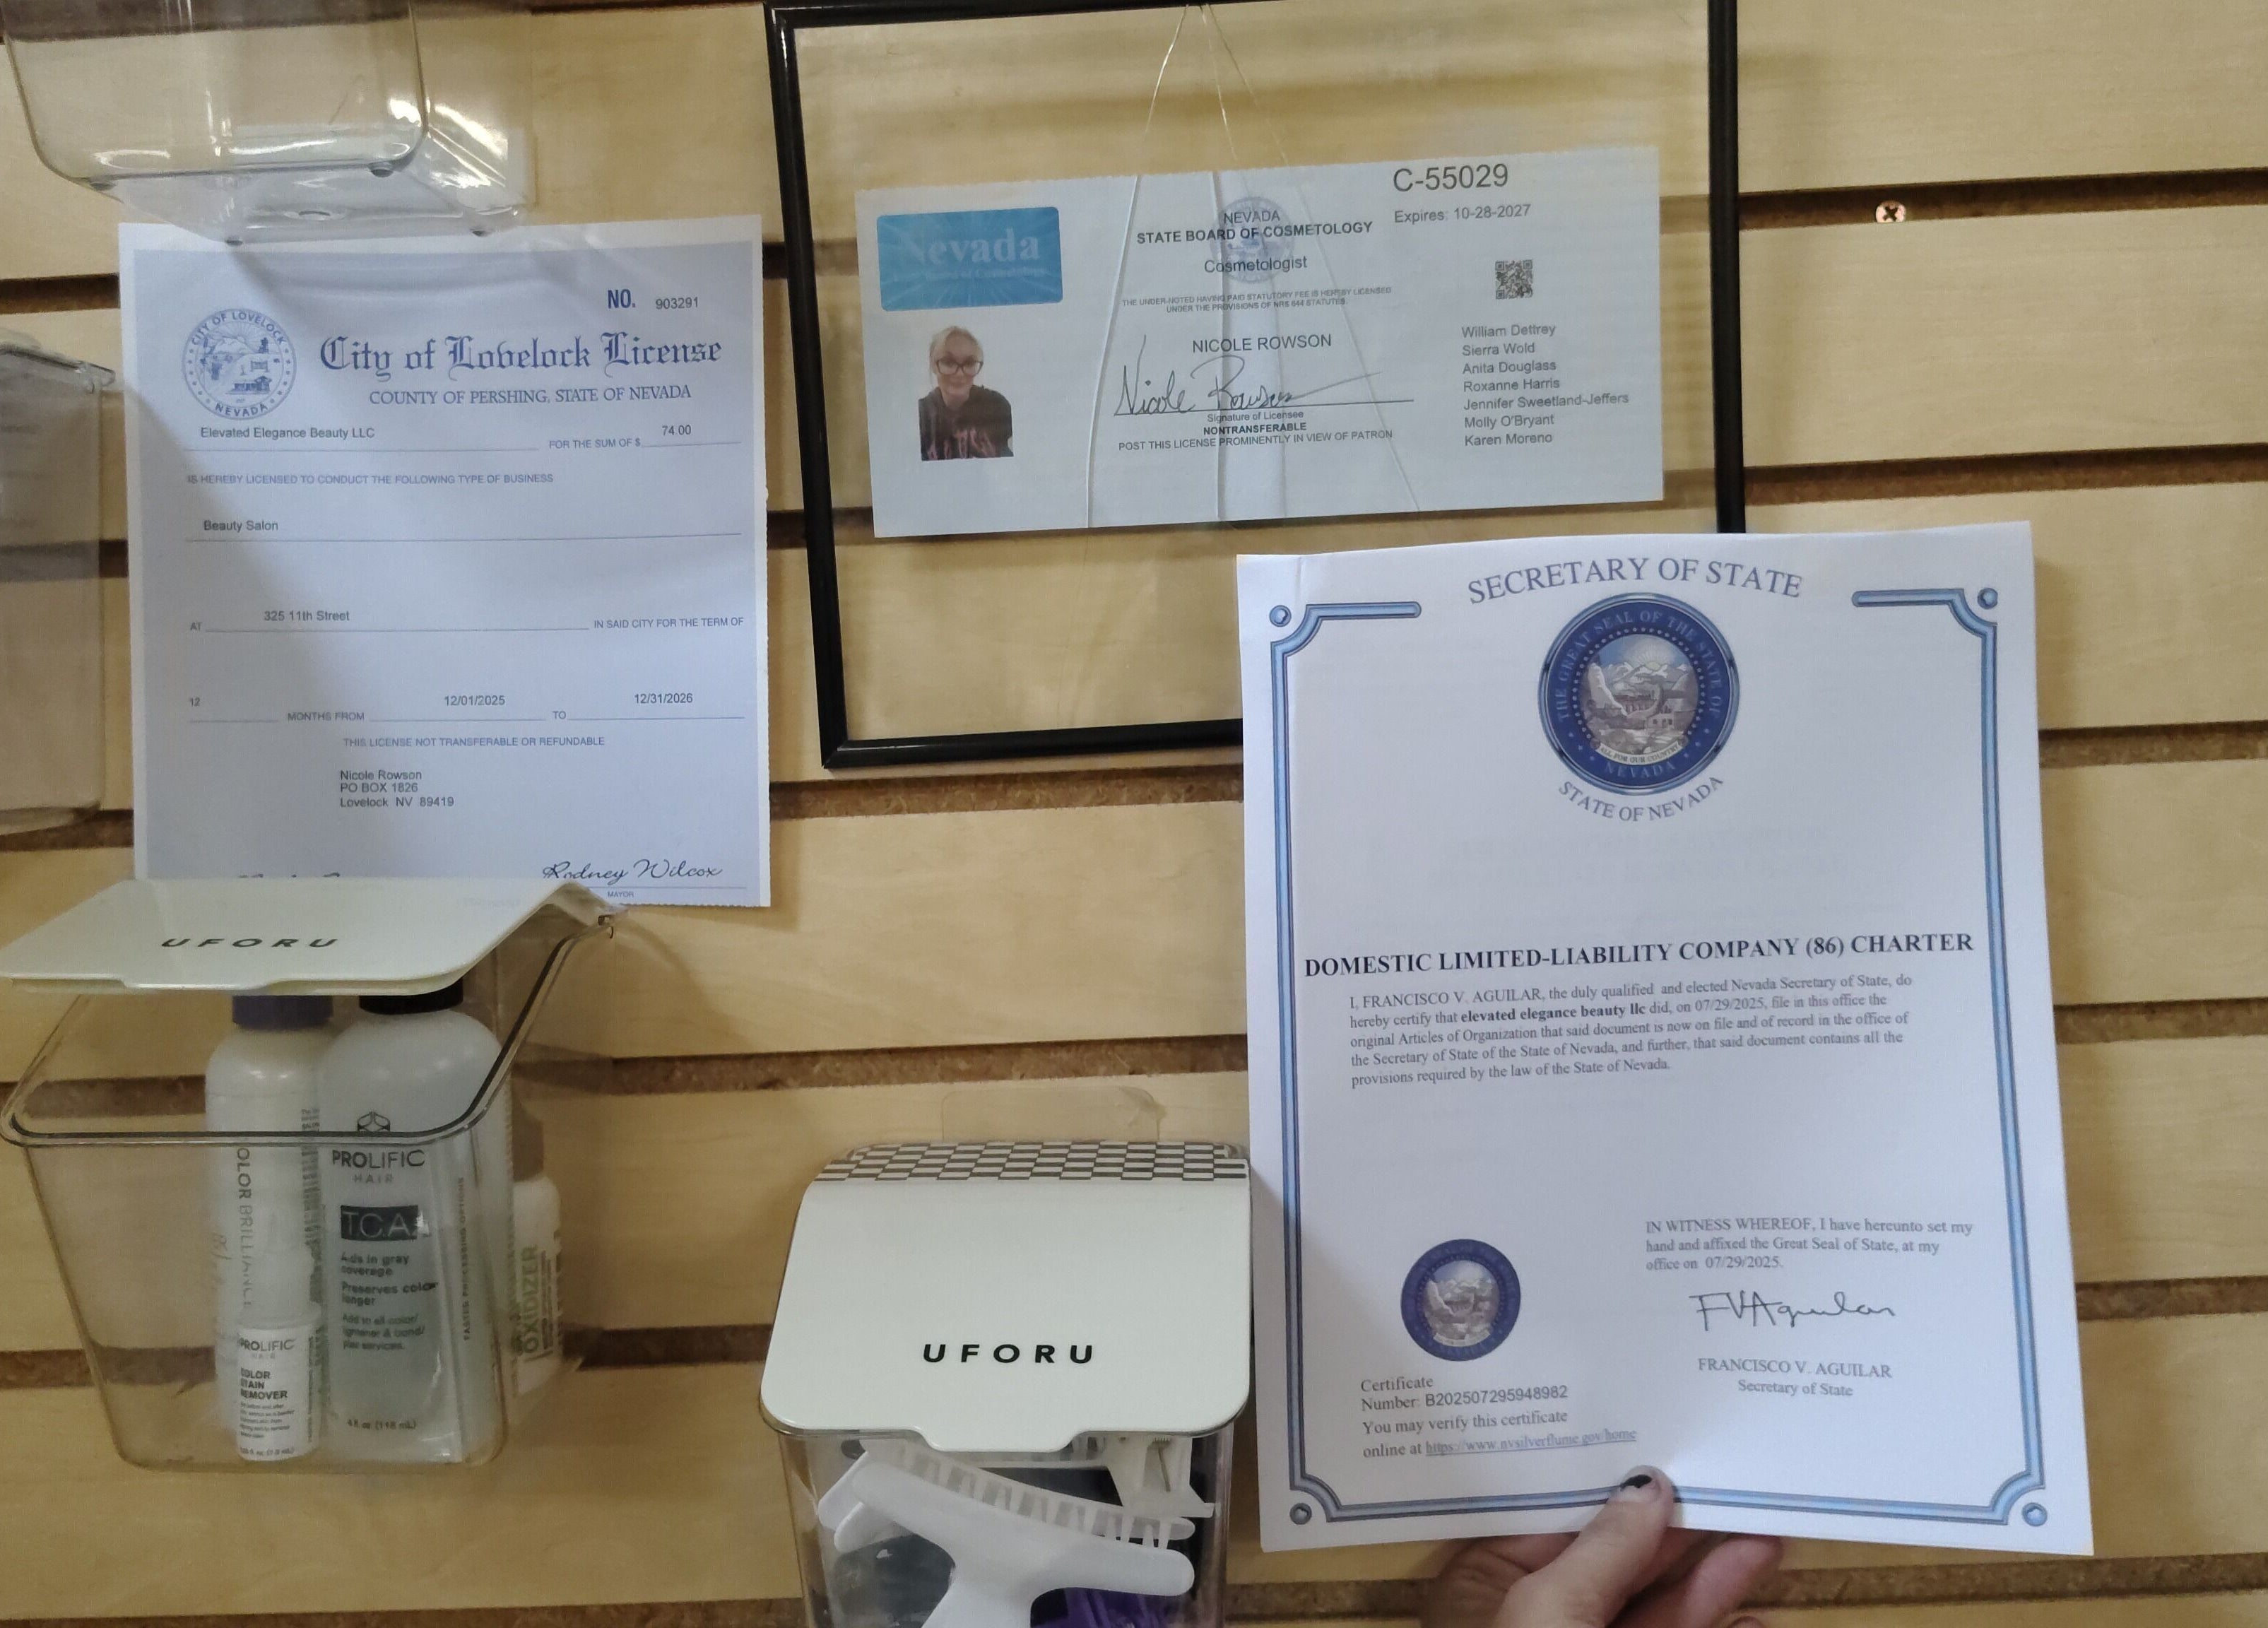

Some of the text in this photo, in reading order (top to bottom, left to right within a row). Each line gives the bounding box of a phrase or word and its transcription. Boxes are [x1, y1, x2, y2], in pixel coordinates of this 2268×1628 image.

[1393, 163, 1508, 191] C-55029
[1223, 210, 1280, 224] NEVADA
[1454, 204, 1530, 219] 10-28-2027
[1137, 222, 1372, 244] STATE BOARD OF COSMETOLOGY
[1204, 256, 1306, 276] Cosmetologist
[608, 288, 697, 309] NO. 903291
[191, 311, 286, 346] CITY OF LOVELOCK
[1461, 326, 1506, 338] William
[1193, 334, 1330, 353] NICOLE ROWSON
[1462, 342, 1535, 356] Sierra Wold
[320, 331, 721, 382] City of Lovelock License
[1463, 360, 1556, 374] Anita Douglass
[1463, 377, 1559, 391] Roxanne Harris
[369, 391, 437, 404] COUNTY
[443, 391, 465, 403] OF
[555, 388, 598, 402] STATE
[603, 387, 625, 401] OF
[629, 384, 691, 400] NEVADA
[1463, 392, 1629, 410] Jennifer Sweetland-Jeffers
[214, 403, 268, 418] NEVADA
[1207, 411, 1303, 424] Signature of Licensee
[1203, 422, 1306, 435] NONTRANSFERABLE
[1464, 413, 1554, 430] Molly O'Bryant
[200, 427, 374, 440] Elevated Elegance Beauty LLC
[662, 424, 691, 435] 74.00
[549, 440, 569, 449] FOR
[572, 439, 591, 448] THE
[594, 438, 615, 447] SUM
[618, 437, 632, 447] OF
[1465, 432, 1552, 446] Karen Moreno
[203, 519, 278, 533] Beauty Salon
[1468, 558, 1803, 604] SECRETARY OF STATE
[264, 610, 349, 620] 325 11th Street
[189, 622, 201, 630] AT
[189, 697, 200, 707] 12
[444, 695, 504, 705] 12/01/2025
[634, 692, 692, 704] 12/31/2026
[287, 712, 364, 720] MONTHS FROM
[552, 710, 567, 719] TO
[343, 736, 604, 746] THIS LICENSE NOT TRANSFERABLE OR REFUNDABLE
[340, 769, 421, 780] Nicole Rowson
[340, 782, 418, 793] PO BOX 1826
[340, 796, 454, 807] Lovelock NV 89419
[1557, 777, 1723, 821] STATE OF NEVADA
[543, 859, 723, 885] Rodney Wilcox
[161, 938, 340, 949] UFORU
[1304, 933, 1973, 976] DOMESTIC LIMITED-LIABILITY COMPANY (86) CHARTER
[1349, 1014, 1388, 1030] hereby
[1393, 1012, 1431, 1027] certify
[1435, 1010, 1457, 1022] that
[1460, 1008, 1516, 1022] elevated
[1520, 1007, 1576, 1022] elegance
[1581, 1005, 1625, 1018] beauty
[1630, 1003, 1646, 1015] llc
[1649, 1001, 1672, 1013] did,
[1676, 1003, 1690, 1012] on
[1772, 996, 1789, 1007] file
[1794, 998, 1803, 1007] in
[1808, 995, 1828, 1006] this
[1833, 993, 1864, 1005] office
[1869, 993, 1886, 1005] the
[332, 1150, 425, 1168] PROLIFIC
[237, 1146, 252, 1200] OLOR
[923, 1343, 1094, 1364] UFORU
[1698, 1357, 1791, 1373] FRANCISCO
[1815, 1362, 1891, 1377] AGUILAR
[1360, 1376, 1433, 1391] Certificate
[1738, 1379, 1853, 1396] Secretary of State
[1425, 1384, 1567, 1407] B202507295948982
[1362, 1410, 1567, 1434] You may verify this certificate
[1363, 1443, 1405, 1458] online
[1410, 1443, 1422, 1454] at
